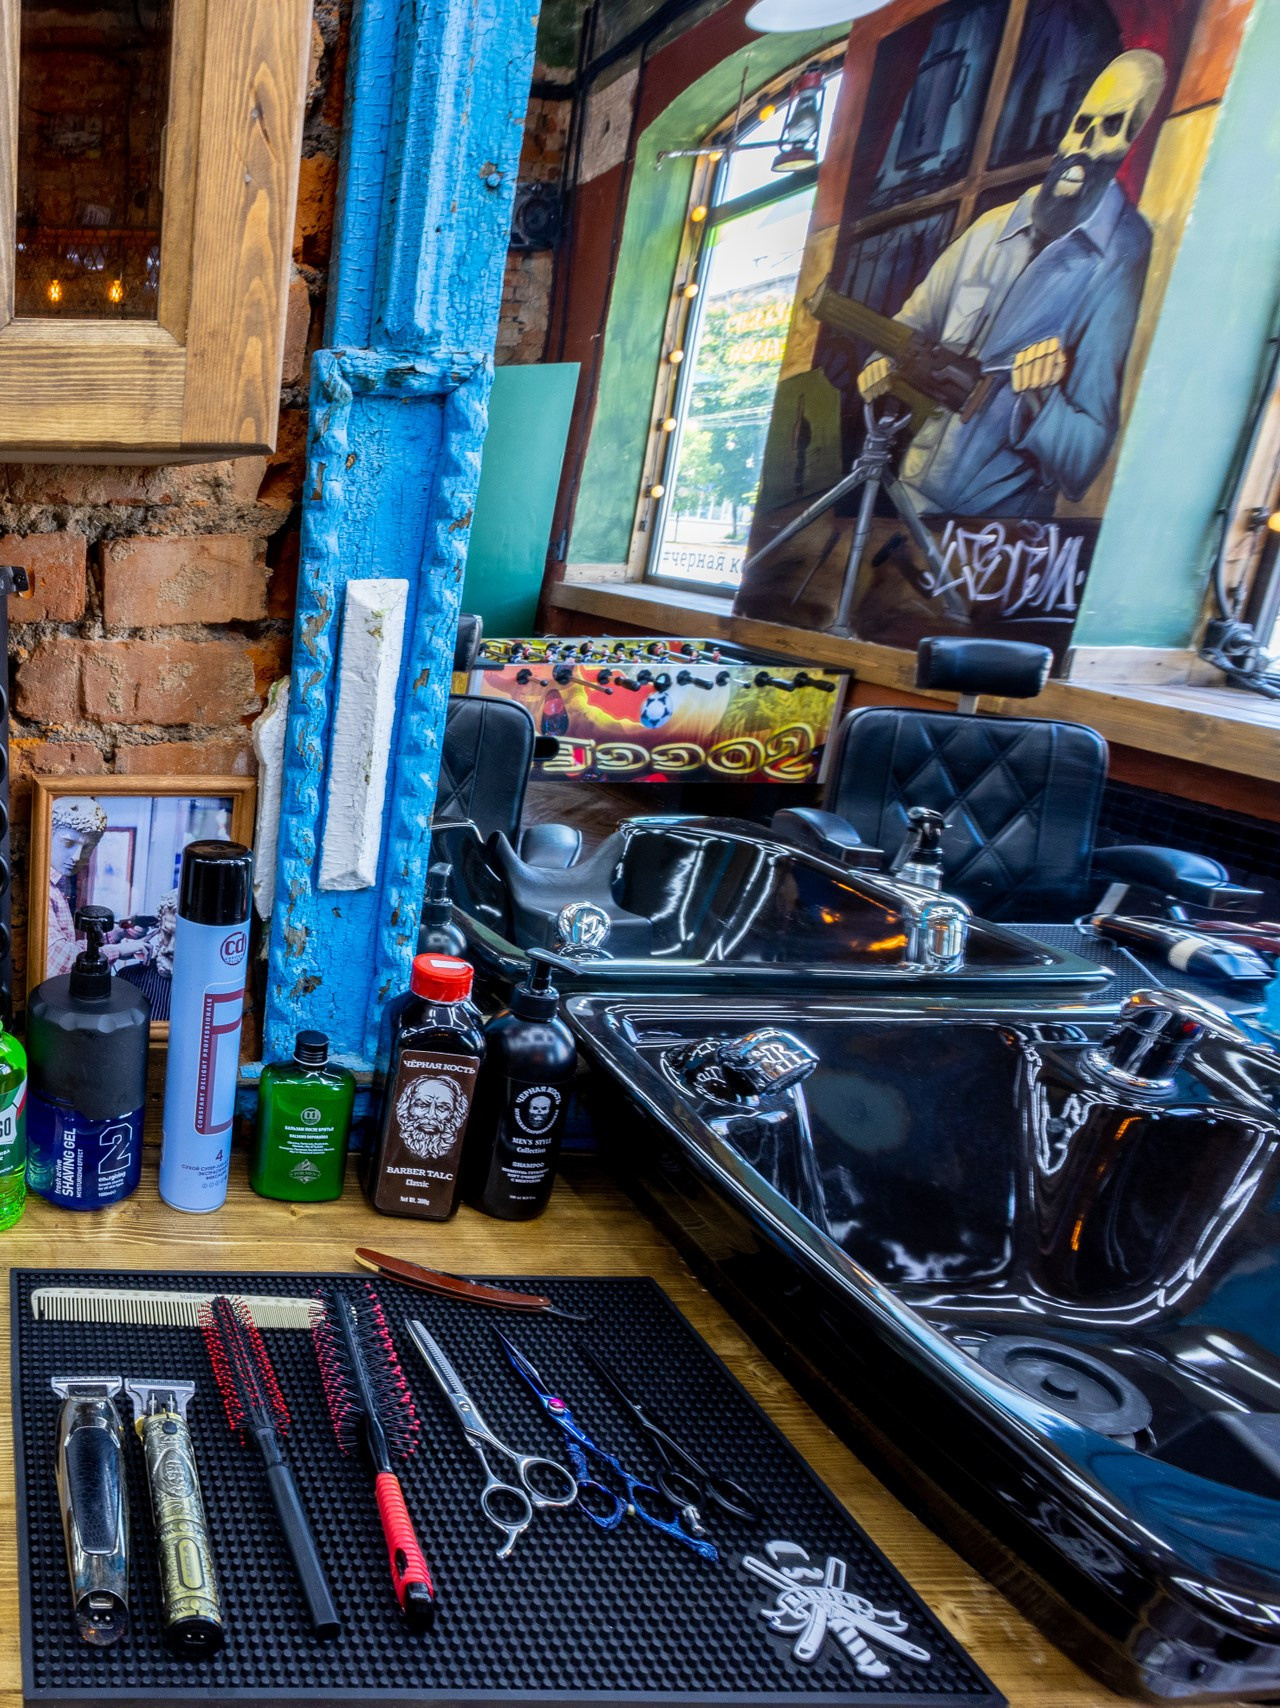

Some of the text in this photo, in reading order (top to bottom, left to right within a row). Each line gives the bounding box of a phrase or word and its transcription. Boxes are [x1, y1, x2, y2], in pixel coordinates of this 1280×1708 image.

[197, 998, 213, 1129] CONSTANT DELIGHT PROFESSIONALE
[403, 1059, 476, 1075] ЧЁРНАЯ КОСТЬ
[98, 1122, 133, 1174] 2
[215, 1149, 223, 1161] 4
[61, 1128, 76, 1197] SHAVING GEL
[512, 1161, 545, 1169] SHAMPOO
[386, 1165, 454, 1181] BARBER TALC
[54, 1177, 62, 1195] fresh
[405, 1178, 430, 1188] Classic
